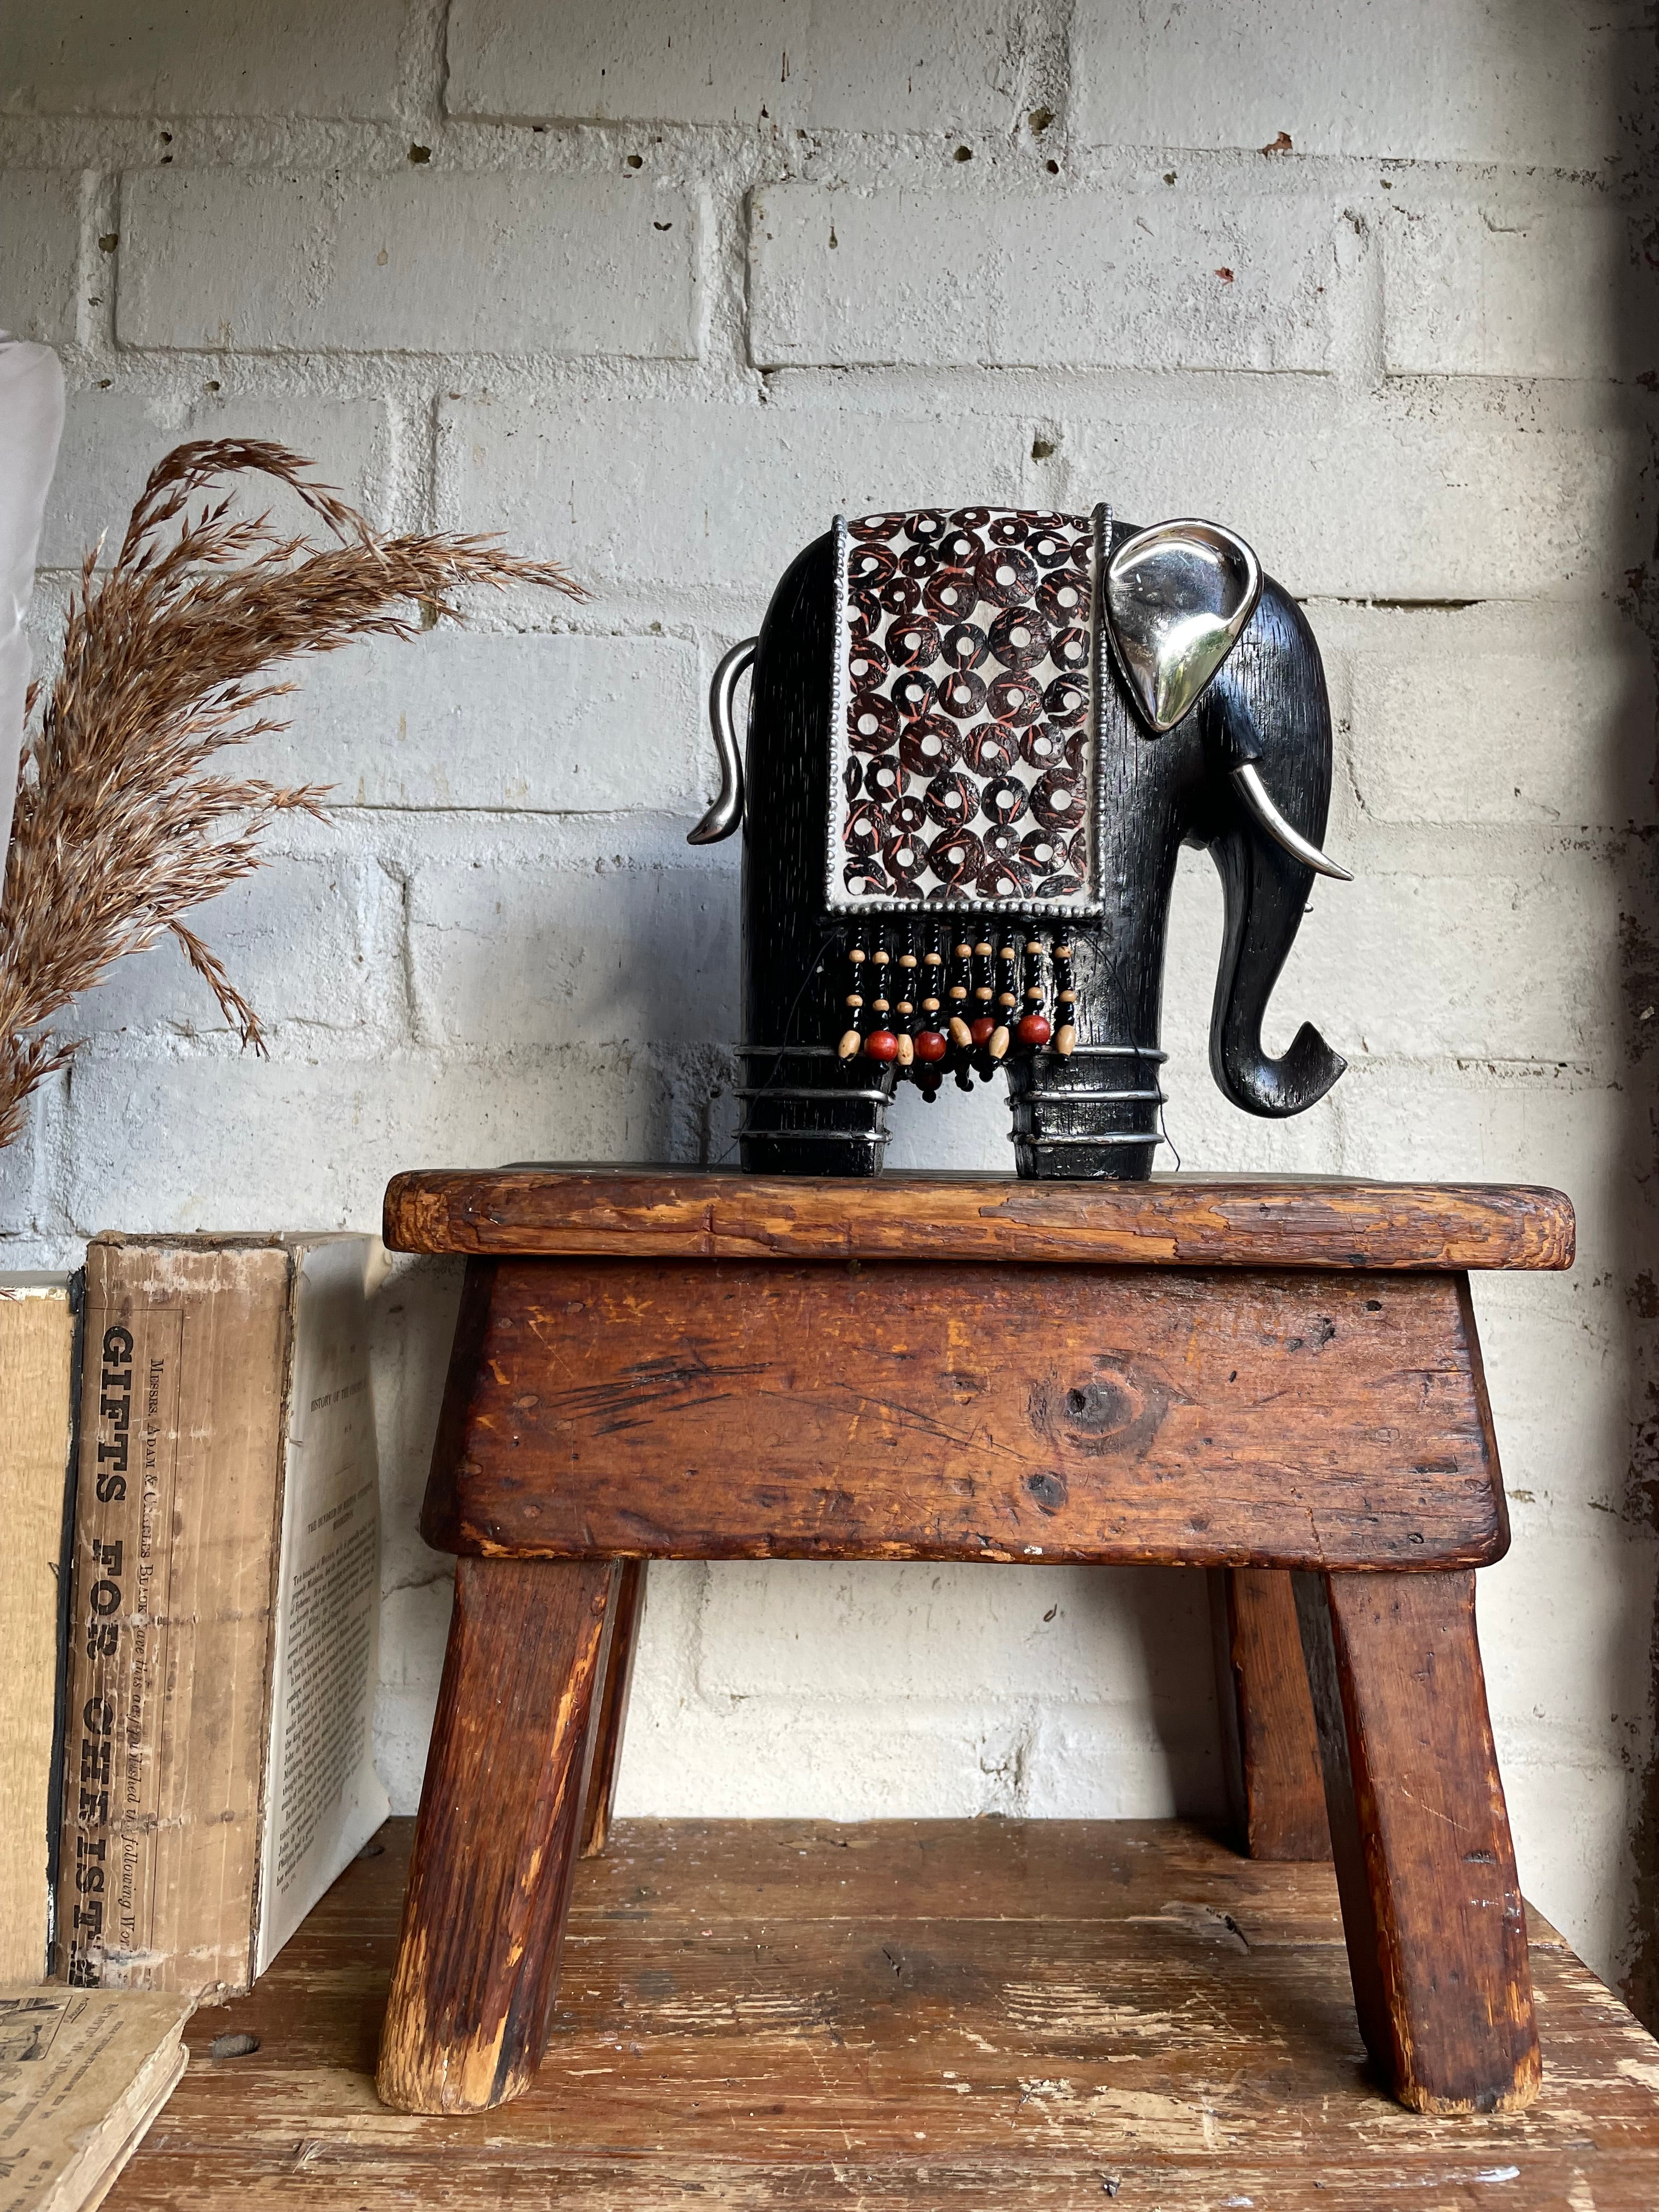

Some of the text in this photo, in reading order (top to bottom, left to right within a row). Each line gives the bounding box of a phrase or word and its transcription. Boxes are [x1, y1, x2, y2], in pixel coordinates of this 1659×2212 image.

[147, 1359, 163, 1417] MESSRS.
[311, 1393, 331, 1412] HISTORY
[333, 1391, 340, 1403] OF
[95, 1325, 134, 1503] GIFTS
[145, 1423, 160, 1468] ADAM
[144, 1474, 157, 1486] &
[86, 1538, 122, 1660] FOR
[137, 1565, 153, 1613] BLACK
[132, 1661, 147, 1688] this
[125, 1728, 142, 1803] published
[124, 1809, 139, 1832] th
[117, 1835, 138, 1909] following
